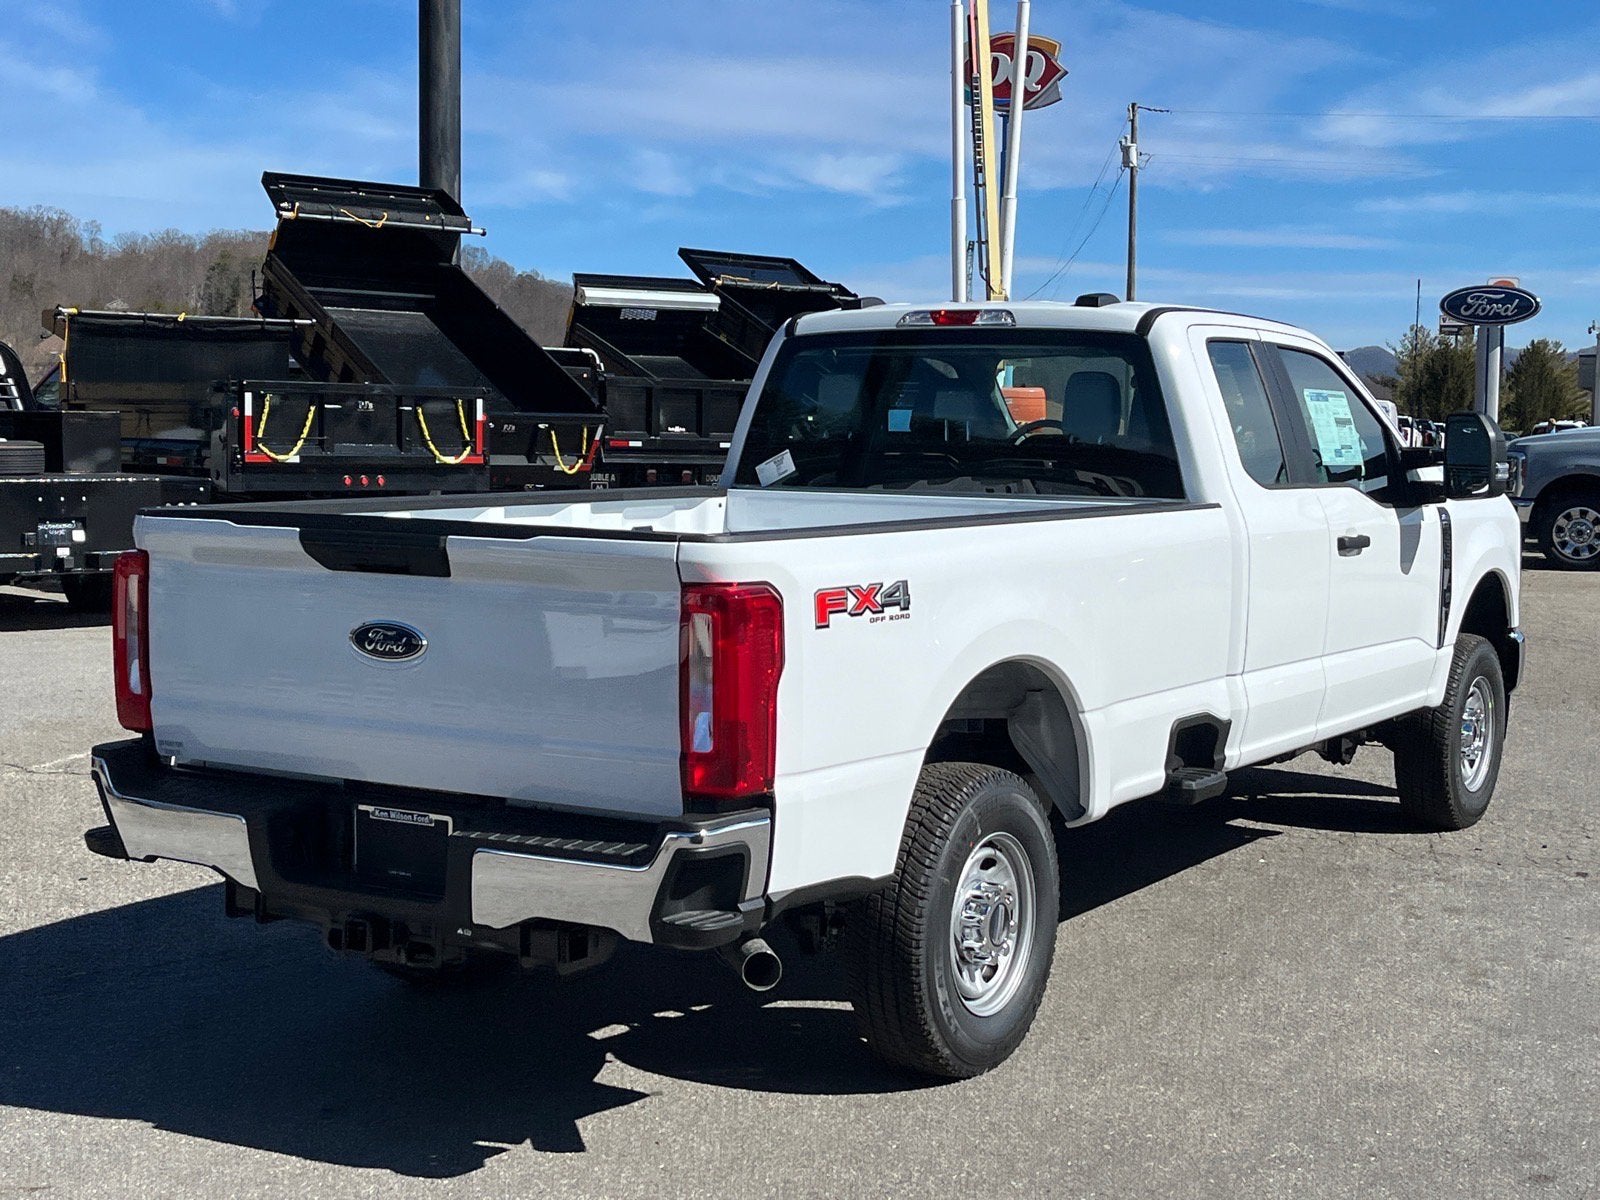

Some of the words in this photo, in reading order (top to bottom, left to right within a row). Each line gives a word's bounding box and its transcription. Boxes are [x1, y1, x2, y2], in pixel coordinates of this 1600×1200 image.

[1460, 292, 1519, 316] Ford
[814, 579, 911, 630] FX4
[869, 616, 887, 624] OFF
[889, 613, 911, 621] ROAD
[365, 628, 407, 653] Ford
[374, 809, 389, 817] Ken
[390, 810, 412, 821] Wilson
[413, 814, 430, 823] Ford
